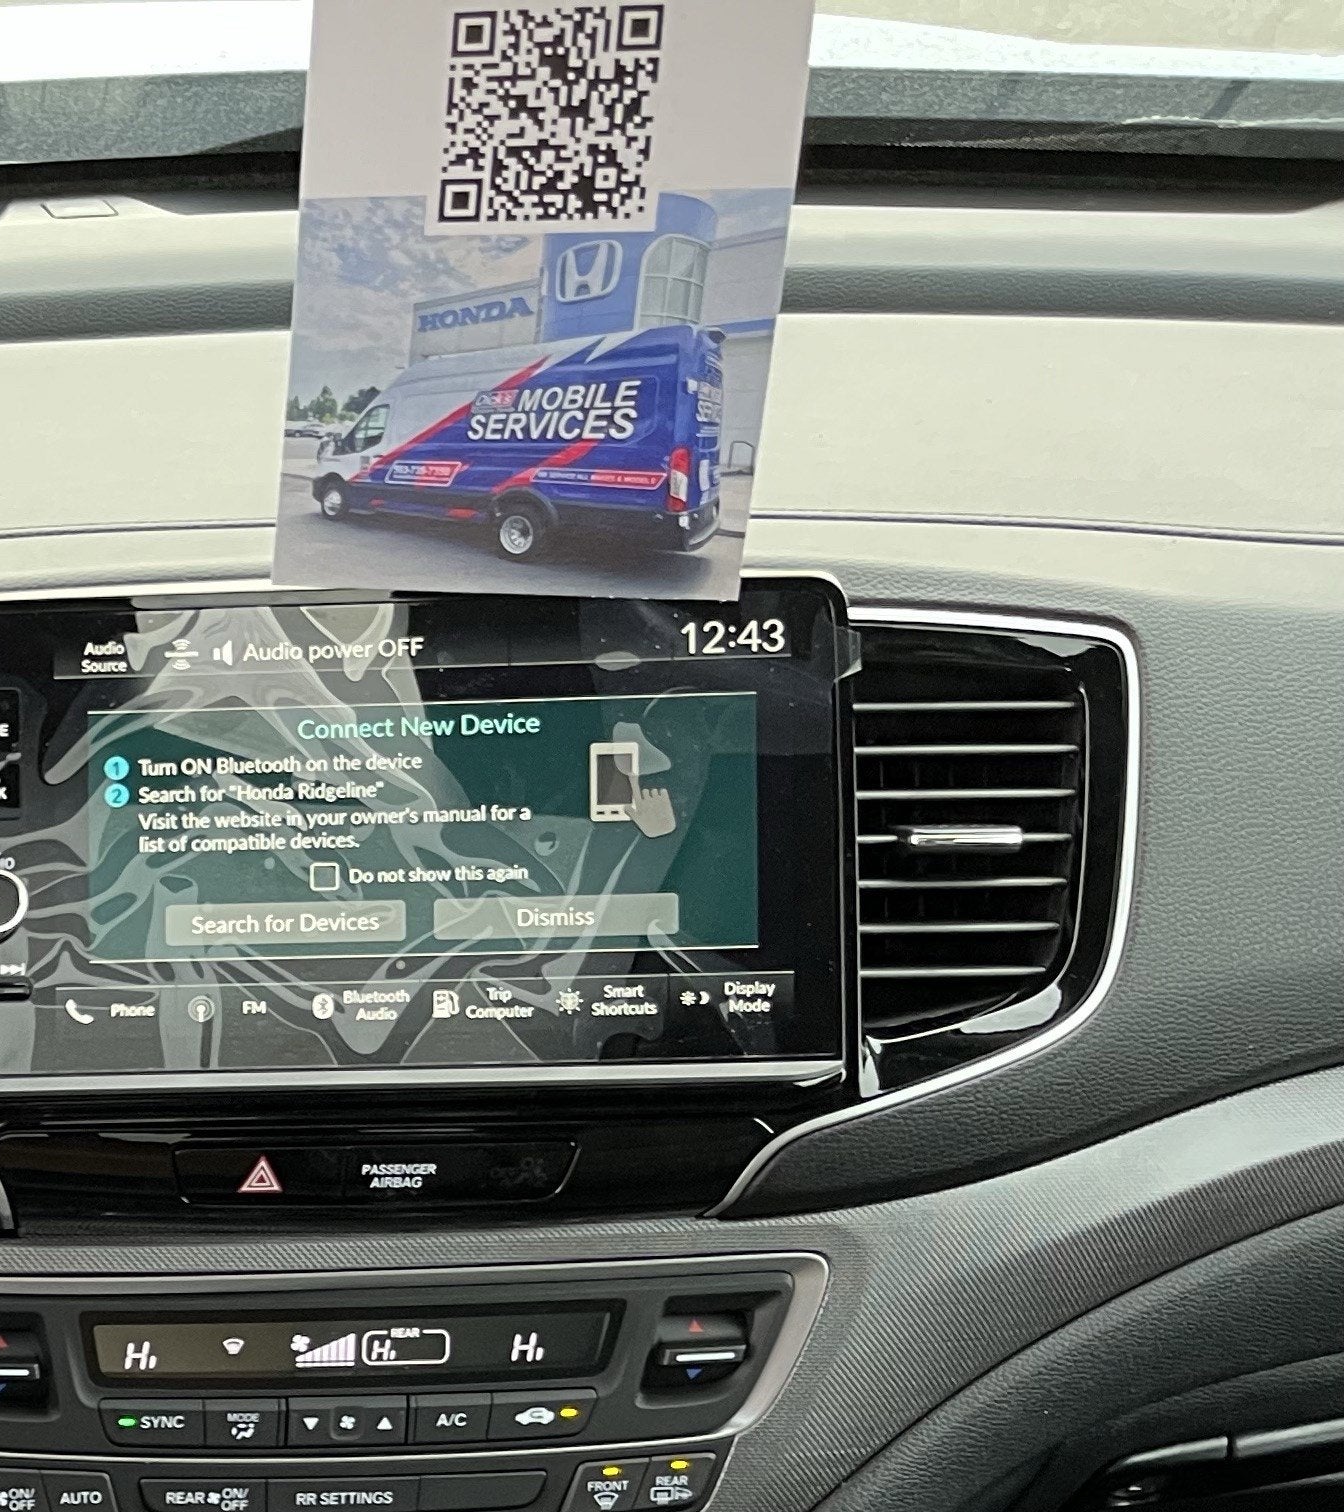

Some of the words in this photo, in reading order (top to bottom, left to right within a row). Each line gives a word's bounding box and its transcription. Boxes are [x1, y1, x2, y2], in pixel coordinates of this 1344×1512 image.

[417, 297, 535, 333] HONDA
[518, 380, 641, 412] MOBILE
[467, 408, 638, 440] SERVICES
[680, 618, 786, 656] 12:43
[84, 642, 125, 656] Audio
[243, 643, 303, 662] Audio
[308, 643, 373, 665] power
[378, 637, 424, 657] OFF
[81, 660, 128, 674] Source
[298, 719, 394, 740] Connect
[401, 716, 455, 737] New
[461, 713, 541, 736] Device
[138, 758, 178, 777] Turn
[181, 758, 211, 775] ON
[216, 756, 301, 775] Bluetooth
[306, 759, 328, 772] on
[333, 755, 361, 771] the
[365, 753, 423, 770] device
[138, 786, 196, 804] Search
[199, 785, 225, 802] for
[230, 784, 294, 801] "Honda
[297, 782, 384, 803] Ridgeline"
[138, 812, 178, 830] Visit
[182, 812, 210, 829] the
[214, 810, 282, 828] website
[285, 810, 304, 827] in
[307, 811, 347, 830] your
[350, 808, 419, 826] owner's
[423, 806, 487, 823] manual
[490, 804, 517, 821] for
[519, 808, 531, 821] a
[138, 837, 167, 854] list
[171, 836, 188, 852] of
[193, 834, 286, 854] compatible
[290, 832, 360, 850] devices.
[349, 868, 373, 884] Do
[377, 868, 405, 883] not
[408, 866, 452, 882] show
[454, 865, 484, 881] this
[487, 865, 529, 882] again
[191, 914, 260, 936] Search
[264, 913, 294, 932] for
[300, 912, 380, 933] Devices
[517, 906, 595, 928] Dismiss
[343, 988, 410, 1005] Bluetooth
[486, 986, 512, 1004] Trip
[603, 984, 645, 1000] Smart
[724, 981, 776, 1000] Display
[111, 1003, 155, 1018] Phone
[243, 1001, 267, 1015] FM
[355, 1005, 398, 1021] Audio
[465, 1002, 534, 1020] Computer
[591, 999, 658, 1016] Shortcuts
[728, 997, 771, 1014] Mode
[362, 1164, 437, 1176] PASSENGER
[370, 1177, 423, 1189] AIRBAG
[390, 1328, 420, 1339] REAR
[139, 1416, 186, 1429] SYNC
[226, 1413, 260, 1423] MODE
[436, 1413, 467, 1428] A/C
[587, 1480, 630, 1493] FRONT
[655, 1476, 689, 1487] REAR
[8, 1500, 36, 1511] OFF
[60, 1492, 102, 1504] AUTO
[165, 1492, 205, 1504] REAR
[220, 1500, 249, 1511] OFF
[295, 1492, 318, 1507] RR
[319, 1491, 394, 1506] SETTINGS
